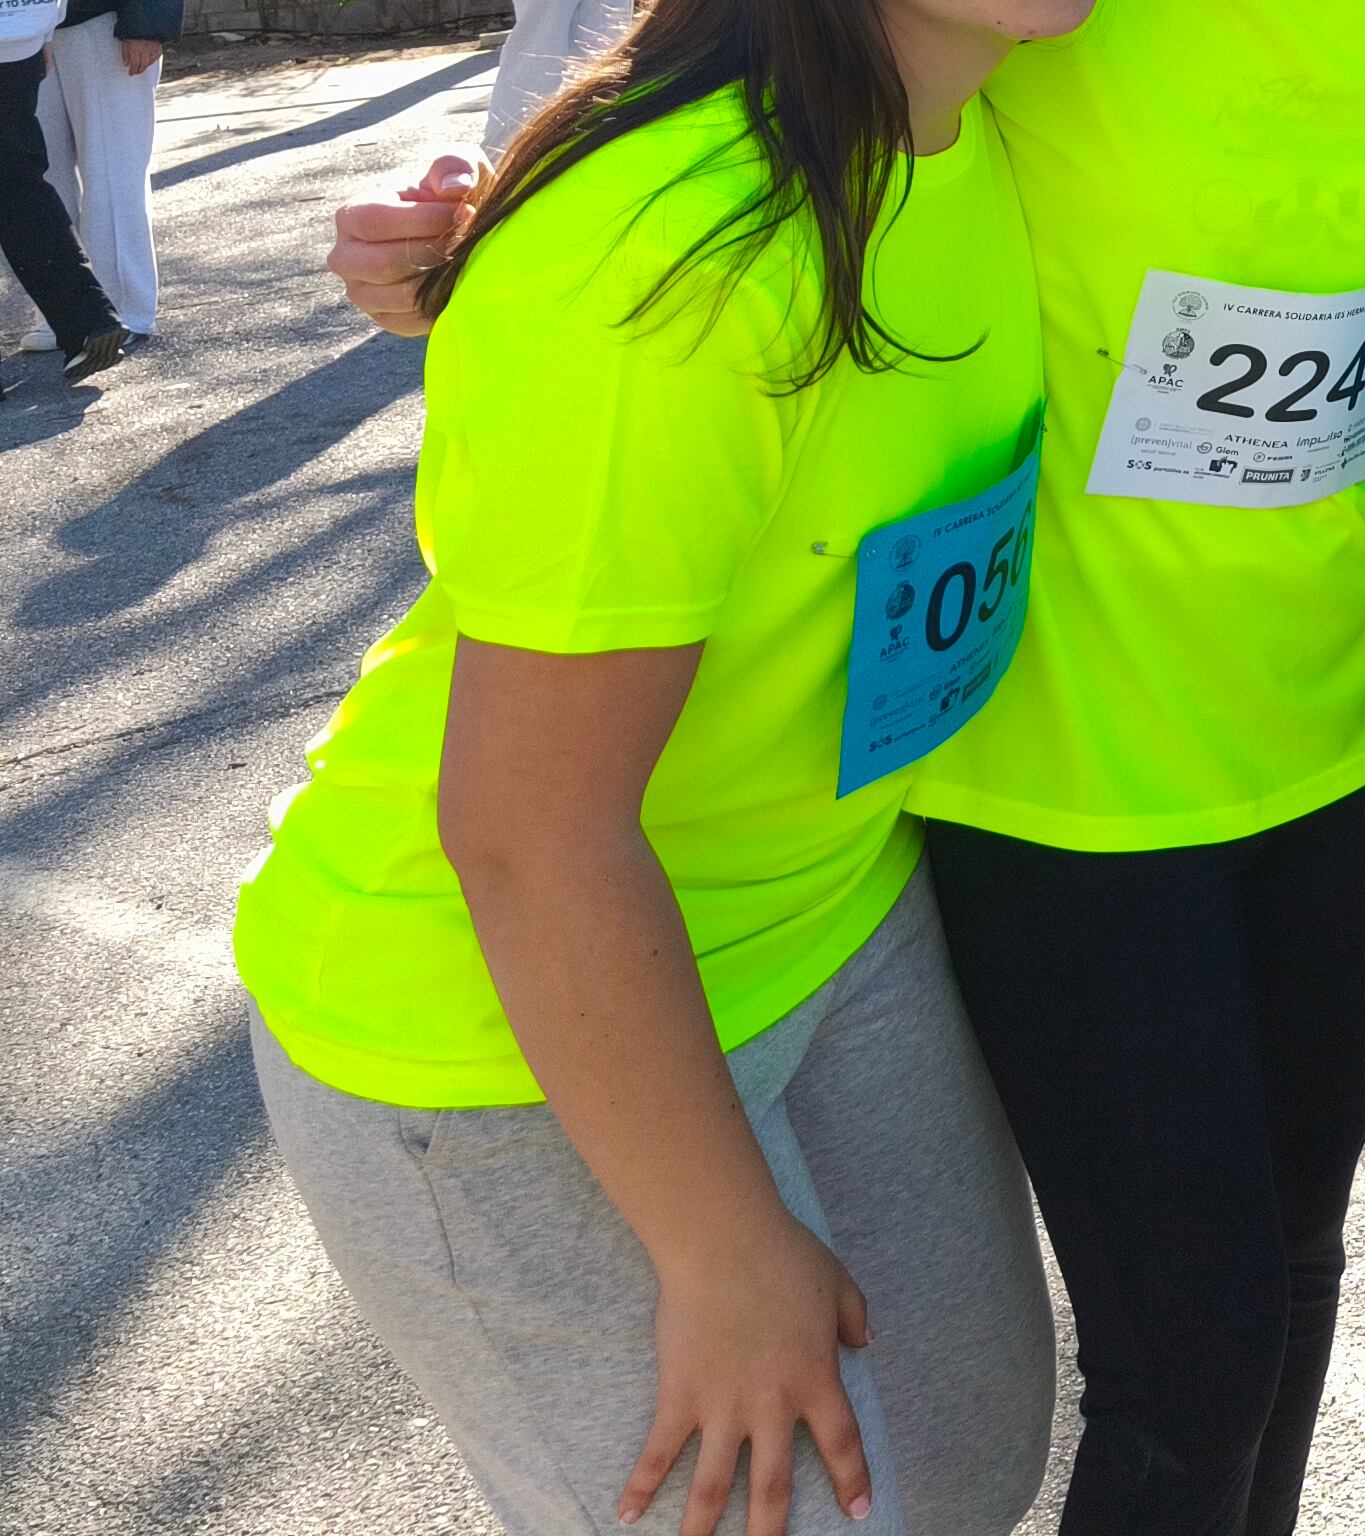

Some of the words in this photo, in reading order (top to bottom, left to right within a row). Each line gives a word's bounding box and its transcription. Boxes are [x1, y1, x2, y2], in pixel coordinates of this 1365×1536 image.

[6, 0, 19, 8] TO
[1223, 303, 1235, 311] IV
[1236, 305, 1282, 319] CARRERA
[1284, 311, 1332, 321] SOLIDARIA
[1335, 311, 1345, 320] IES
[1148, 375, 1184, 388] APAC
[1224, 434, 1288, 449] ATHENEA
[1297, 430, 1342, 448] impulso
[1126, 459, 1153, 471] SOS
[1244, 470, 1290, 482] PRUNITA
[944, 510, 984, 533] CARRERA
[880, 636, 910, 657] APAC
